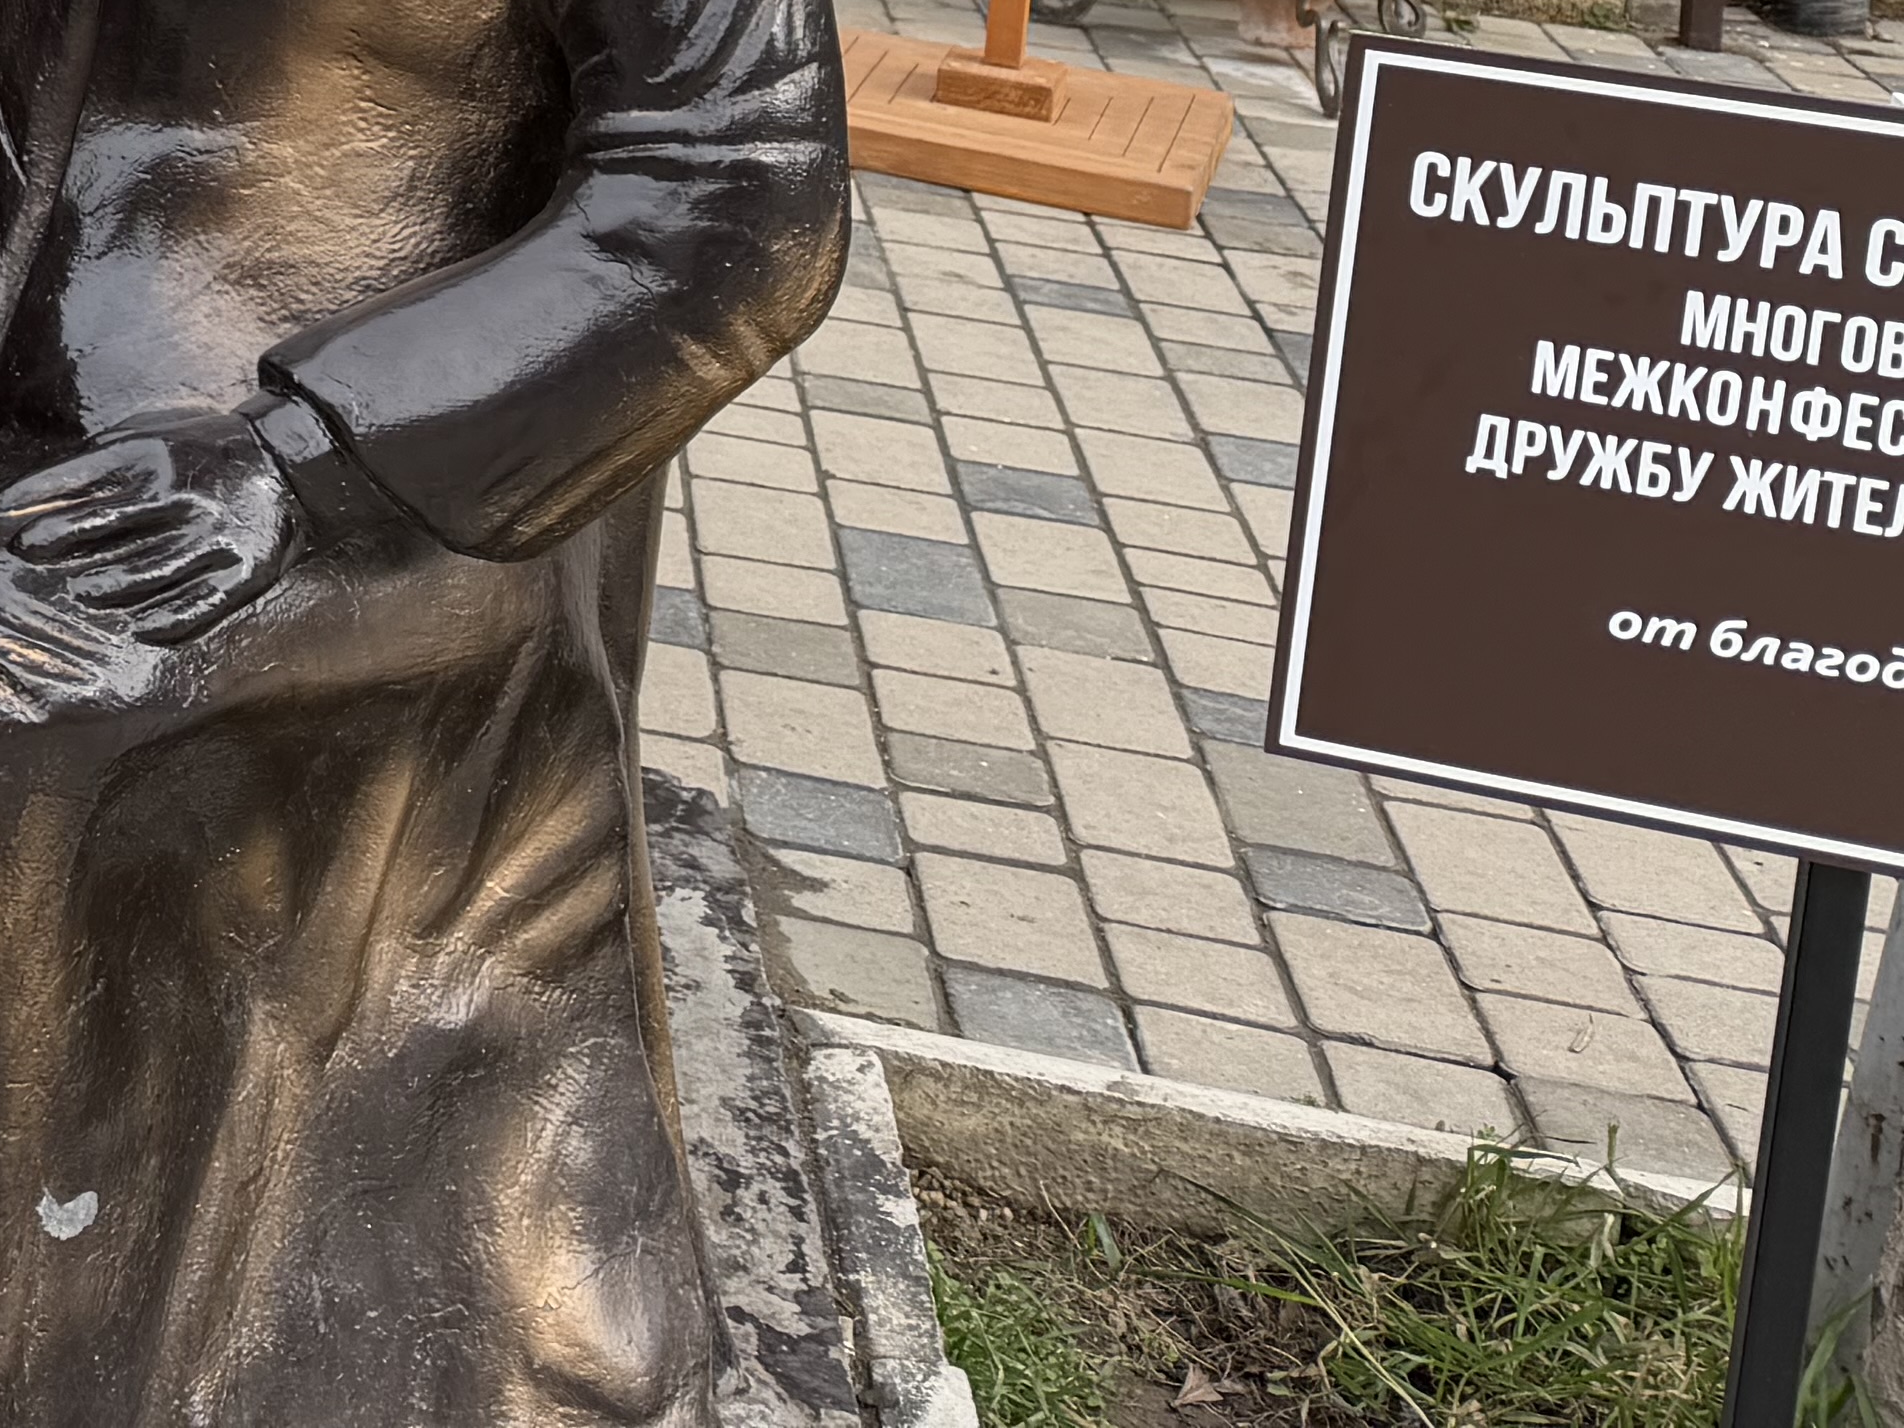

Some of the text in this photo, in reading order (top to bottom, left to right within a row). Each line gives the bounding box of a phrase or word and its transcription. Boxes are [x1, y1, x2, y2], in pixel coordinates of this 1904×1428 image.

[1408, 150, 1844, 280] СКУЛЬПТУРА
[1680, 289, 1904, 379] МНОГОВ
[1530, 340, 1904, 457] МЕЖКОНФЕС
[1464, 413, 1715, 503] ДРУЖБУ
[1608, 610, 1698, 651] от
